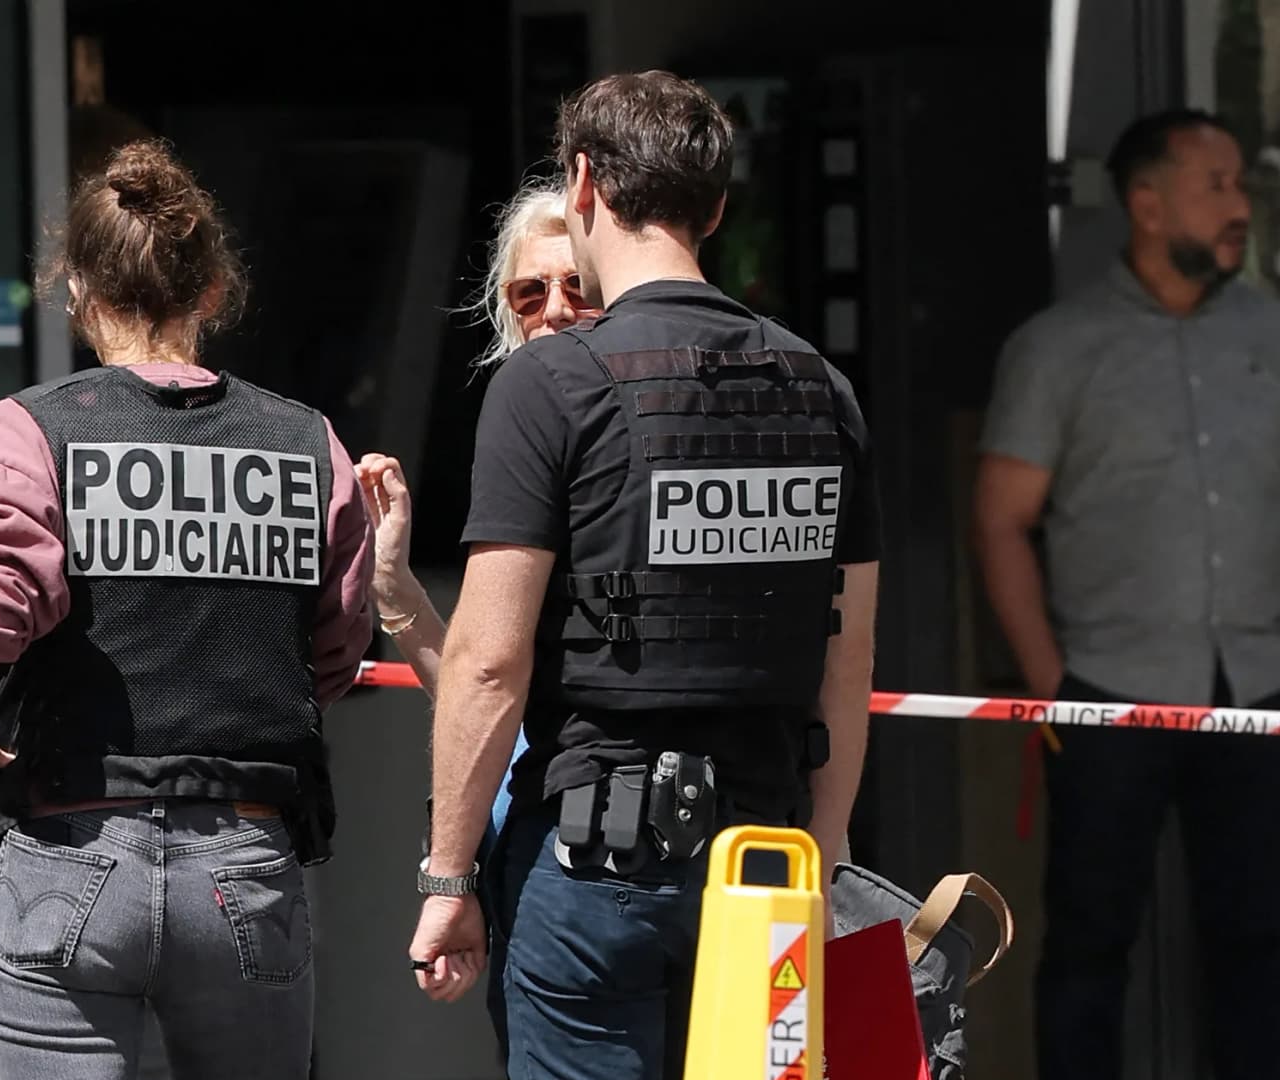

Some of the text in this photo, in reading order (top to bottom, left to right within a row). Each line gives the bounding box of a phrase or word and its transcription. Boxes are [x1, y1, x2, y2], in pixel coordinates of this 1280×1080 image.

[73, 448, 315, 520] POLICE
[657, 476, 839, 520] POLICE
[73, 518, 315, 581] JUDICIAIRE
[653, 524, 837, 556] JUDICIAIRE
[1010, 702, 1116, 726] POLICE
